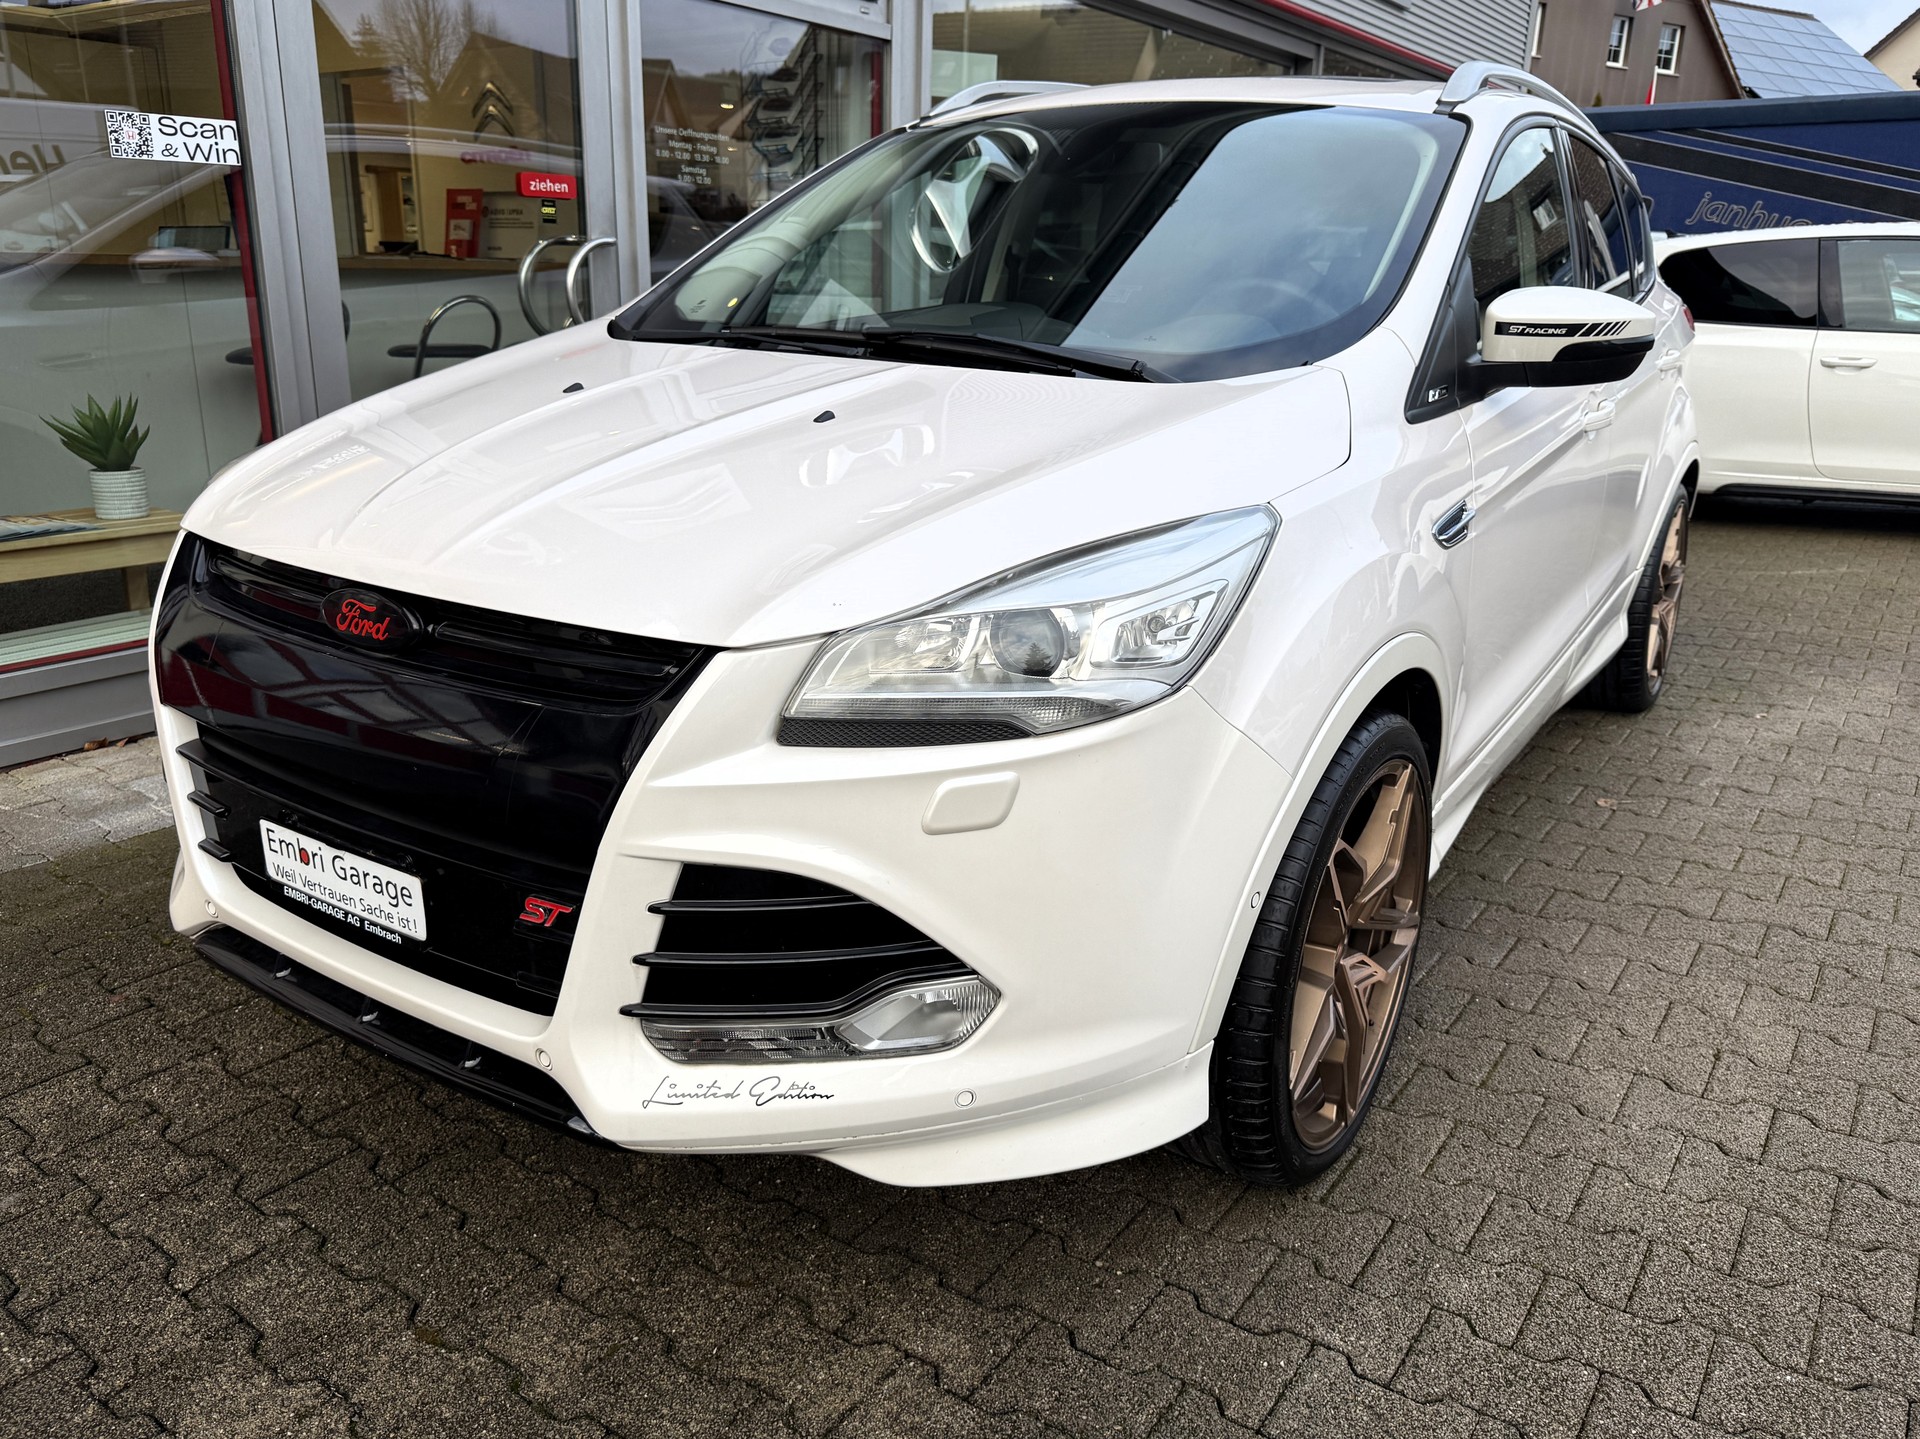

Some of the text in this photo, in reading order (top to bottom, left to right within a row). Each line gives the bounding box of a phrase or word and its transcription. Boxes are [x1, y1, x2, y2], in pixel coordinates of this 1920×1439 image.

[157, 116, 237, 141] Scan
[655, 126, 677, 135] Unsere
[161, 141, 240, 164] & Win
[668, 140, 693, 151] Montag
[696, 143, 718, 155] Freitag
[681, 165, 707, 177] Samstag
[529, 178, 569, 193] ziehen
[1508, 325, 1568, 335] ST RACING
[336, 599, 391, 641] Ford
[266, 827, 413, 908] Embri Garage
[272, 862, 297, 884] Weil
[299, 872, 357, 909] Vertrauen
[360, 897, 395, 923] Sache
[284, 886, 402, 944] EMBRI-GARAGE AG Embrach
[519, 896, 573, 927] ST
[642, 1075, 835, 1109] Limited Edition
